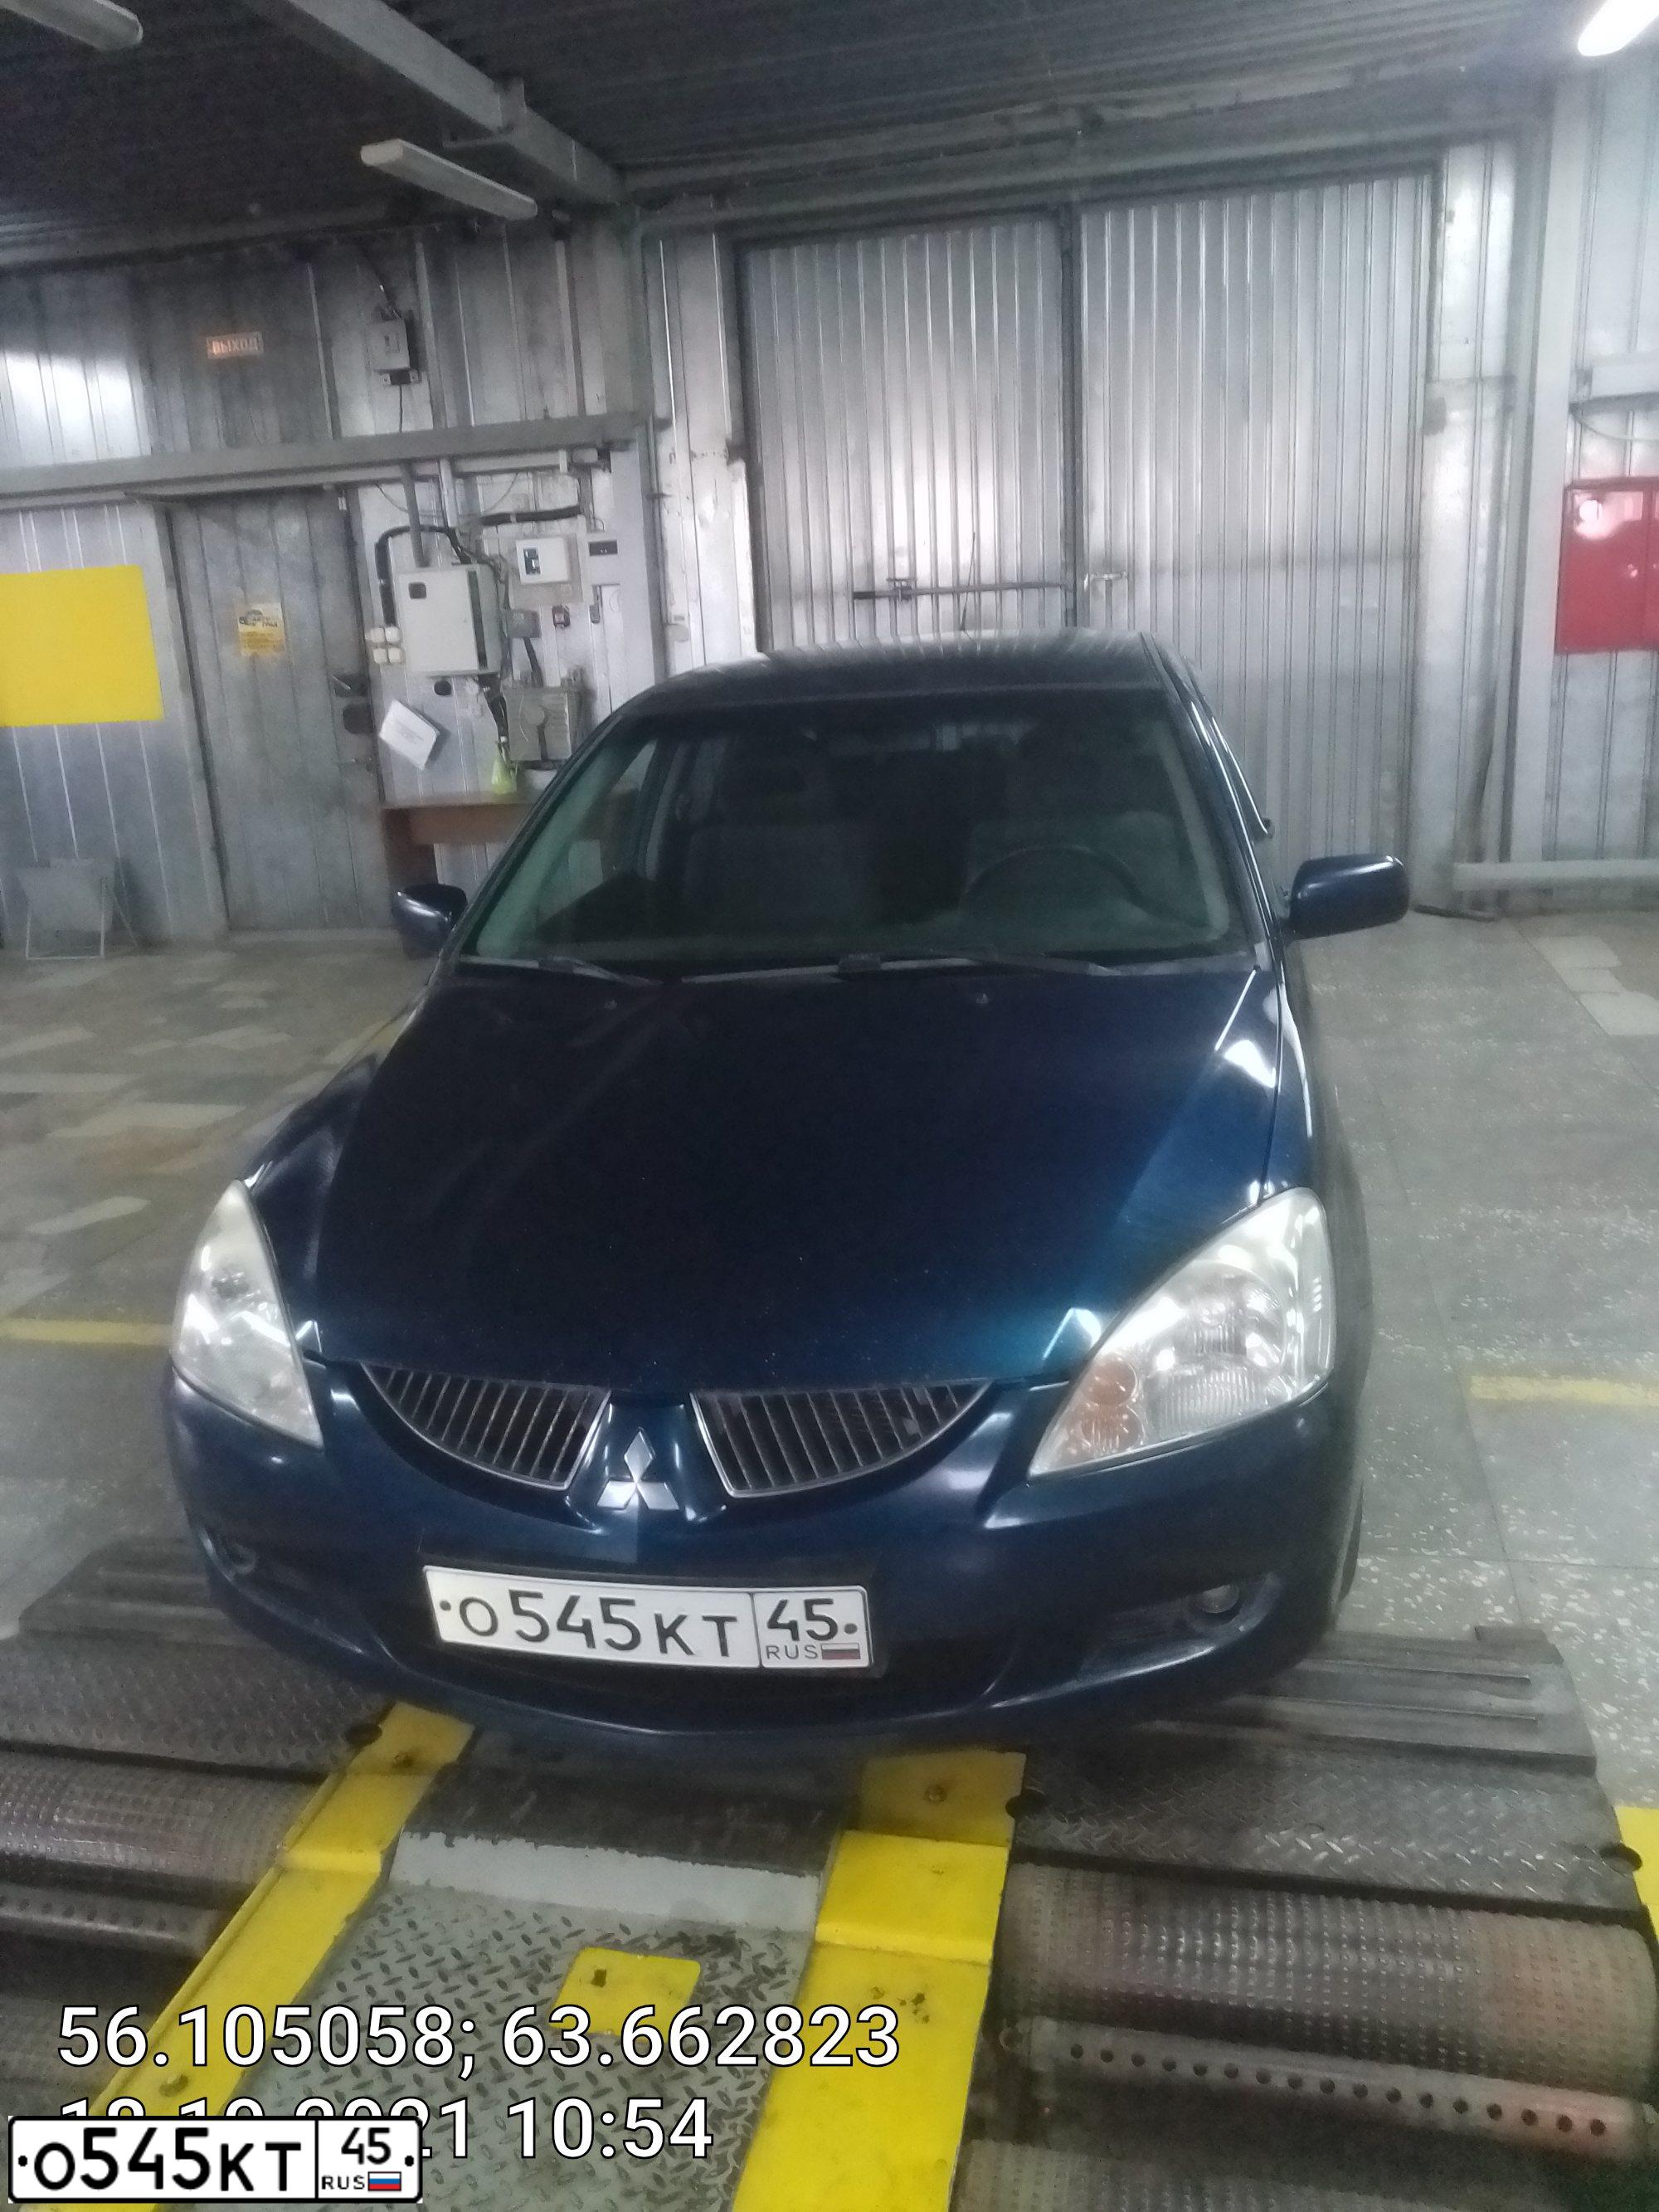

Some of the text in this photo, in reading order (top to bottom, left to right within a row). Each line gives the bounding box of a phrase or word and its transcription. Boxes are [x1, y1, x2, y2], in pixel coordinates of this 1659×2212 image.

[212, 338, 260, 353] ВЫХОД
[766, 1598, 839, 1642] 45
[765, 1644, 820, 1660] RUS
